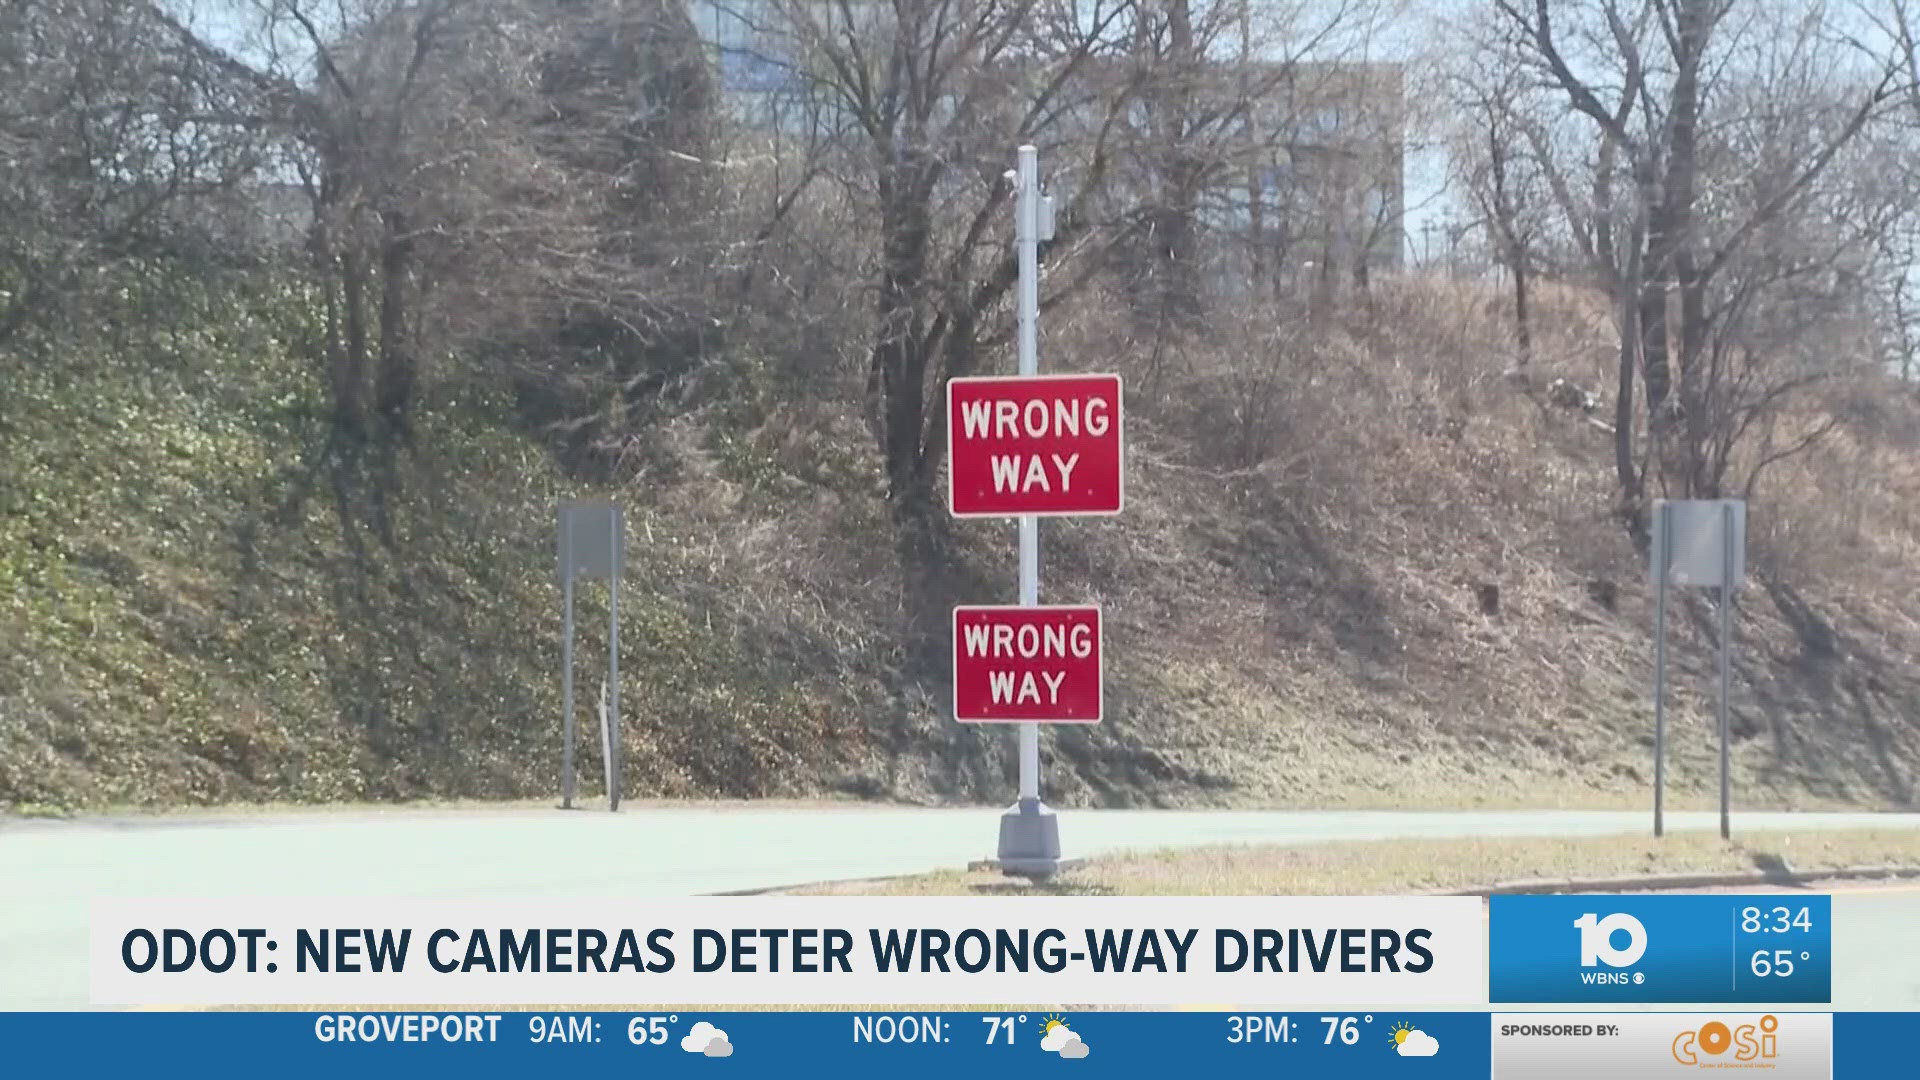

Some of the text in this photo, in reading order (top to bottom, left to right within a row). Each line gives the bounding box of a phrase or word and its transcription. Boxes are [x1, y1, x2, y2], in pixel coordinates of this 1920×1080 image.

[961, 397, 1109, 440] WRONG
[991, 452, 1080, 493] WAY
[964, 623, 1092, 659] WRONG
[989, 670, 1066, 705] WAY
